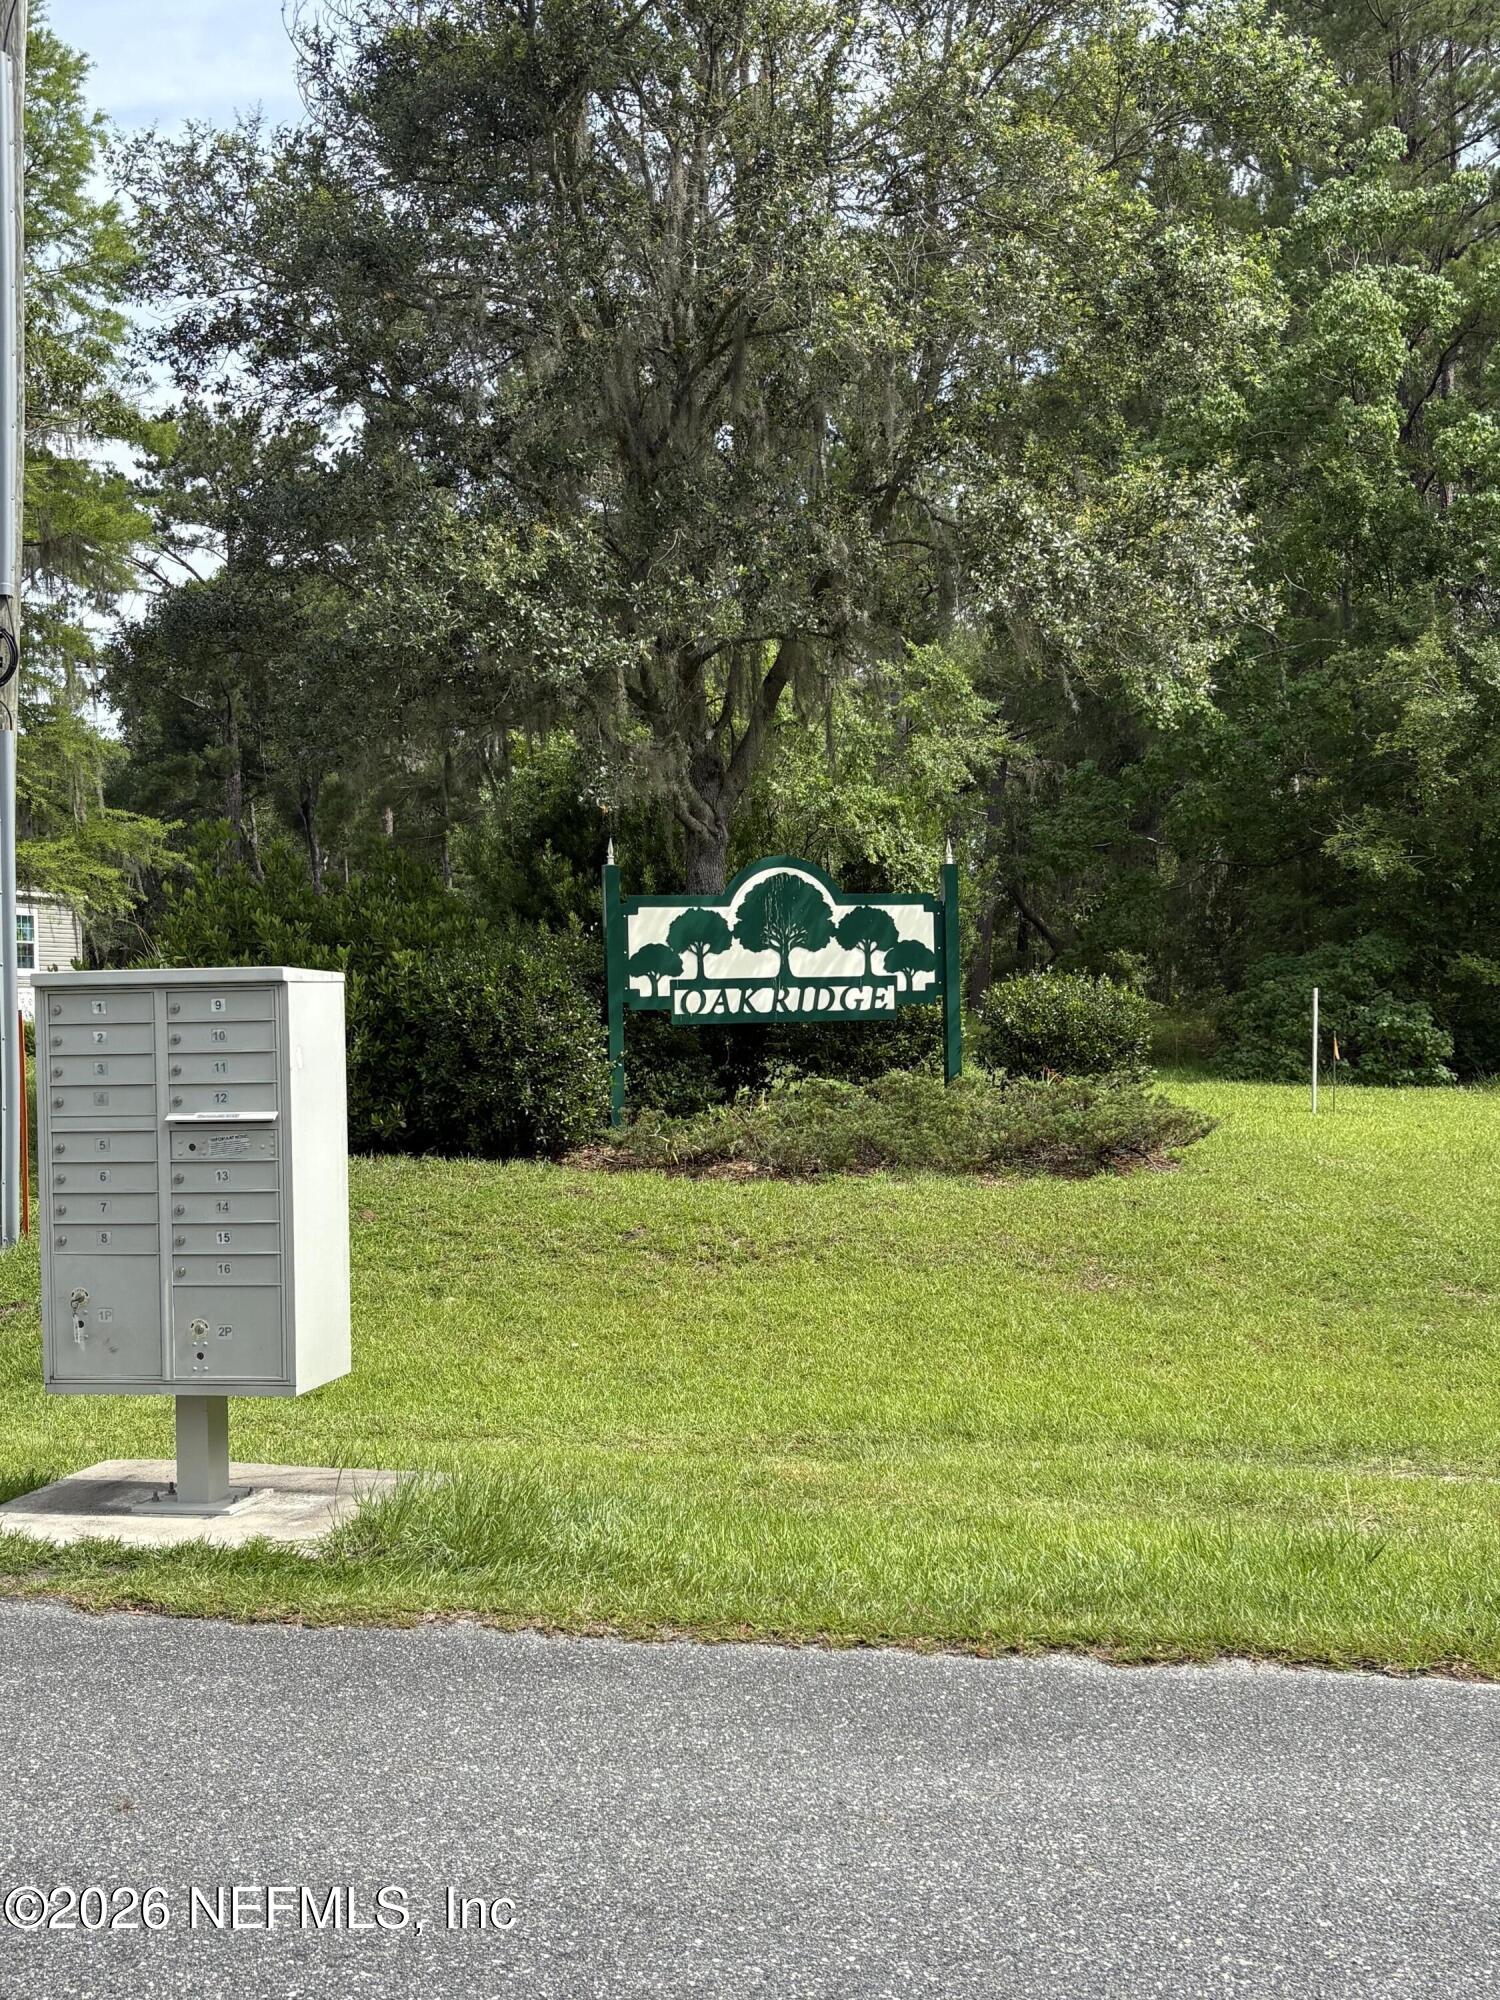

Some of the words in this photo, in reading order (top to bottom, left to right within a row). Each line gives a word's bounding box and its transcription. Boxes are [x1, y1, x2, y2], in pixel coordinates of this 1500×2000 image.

[215, 1000, 222, 1010] 9
[96, 1033, 104, 1043] 2
[213, 1031, 226, 1041] 10
[97, 1064, 104, 1074] 3
[214, 1062, 226, 1073] 11
[214, 1093, 228, 1103] 12
[99, 1140, 106, 1150] 5
[100, 1172, 106, 1182] 6
[216, 1171, 229, 1181] 13
[100, 1202, 107, 1212] 7
[216, 1202, 229, 1212] 14
[101, 1233, 108, 1243] 8
[218, 1232, 231, 1243] 15
[218, 1264, 231, 1274] 16
[99, 1310, 112, 1321] 1P
[218, 1326, 232, 1337] 2P
